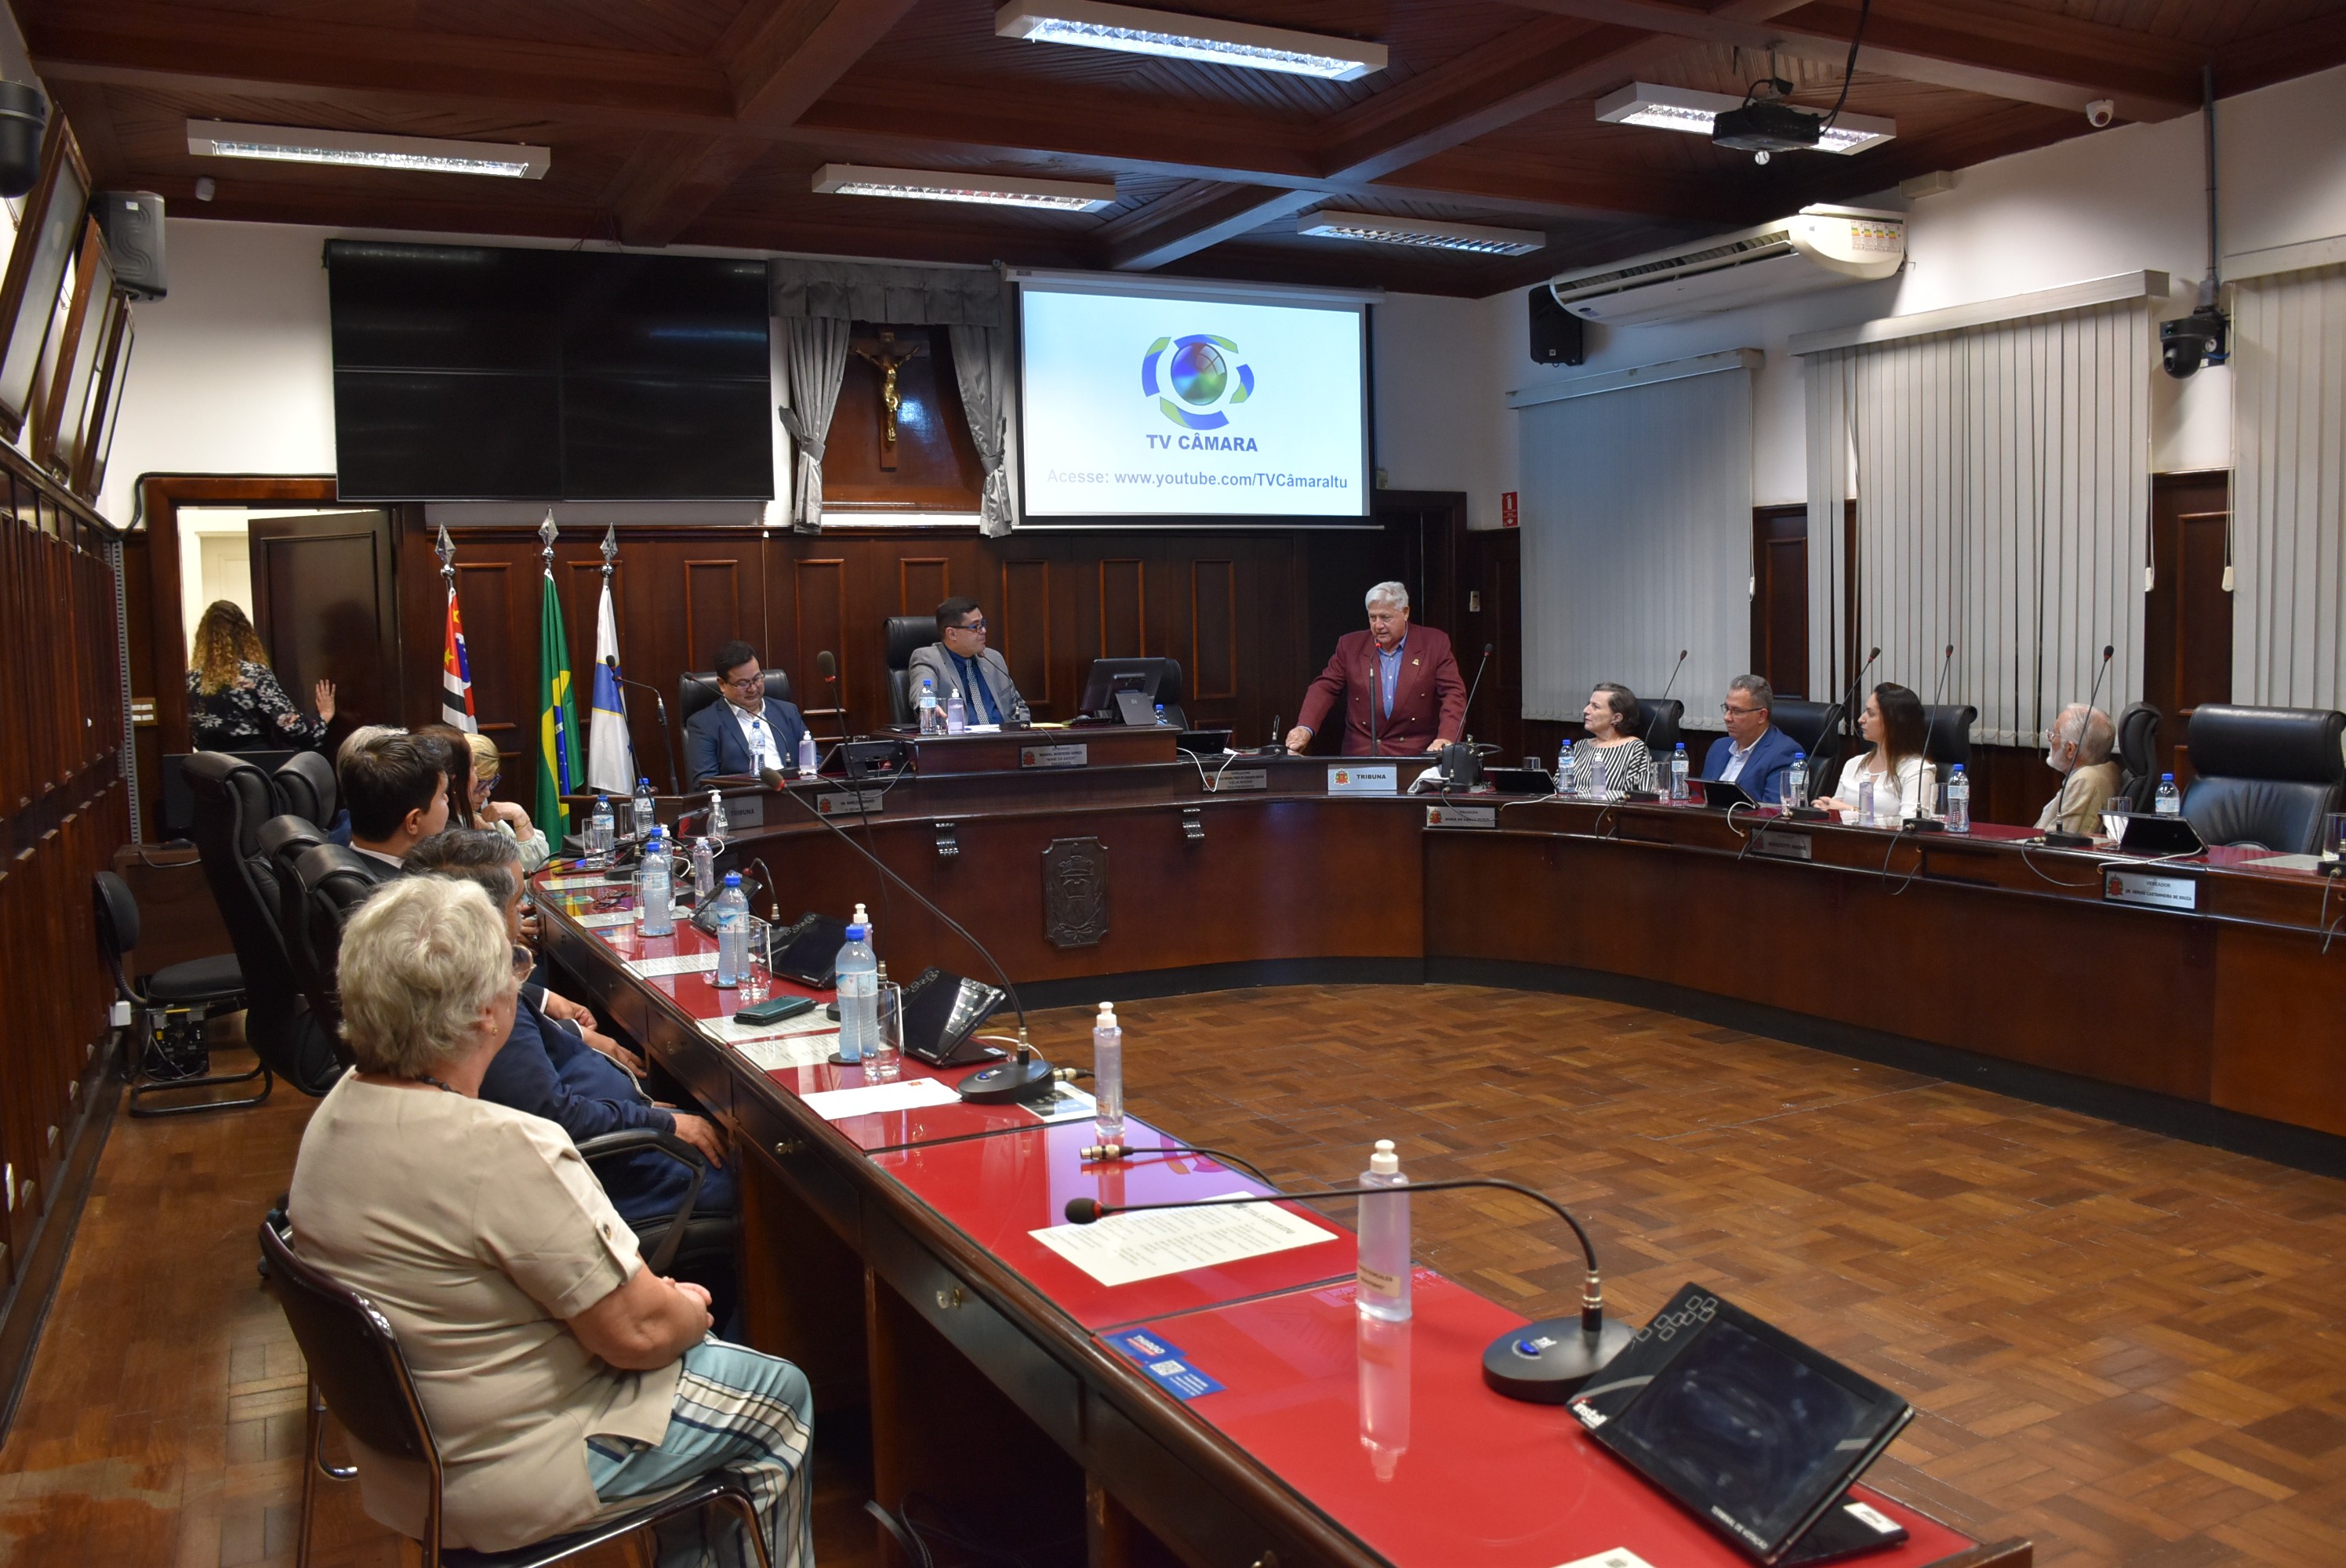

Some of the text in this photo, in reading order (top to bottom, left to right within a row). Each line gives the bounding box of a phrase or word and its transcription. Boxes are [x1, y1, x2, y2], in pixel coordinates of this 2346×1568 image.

[1146, 433, 1258, 452] TV CÂMARA
[1047, 469, 1109, 483] Acesse:
[1573, 1399, 1607, 1426] install
[1711, 1504, 1768, 1550] TERMINAL DE VOTAÇÃO
